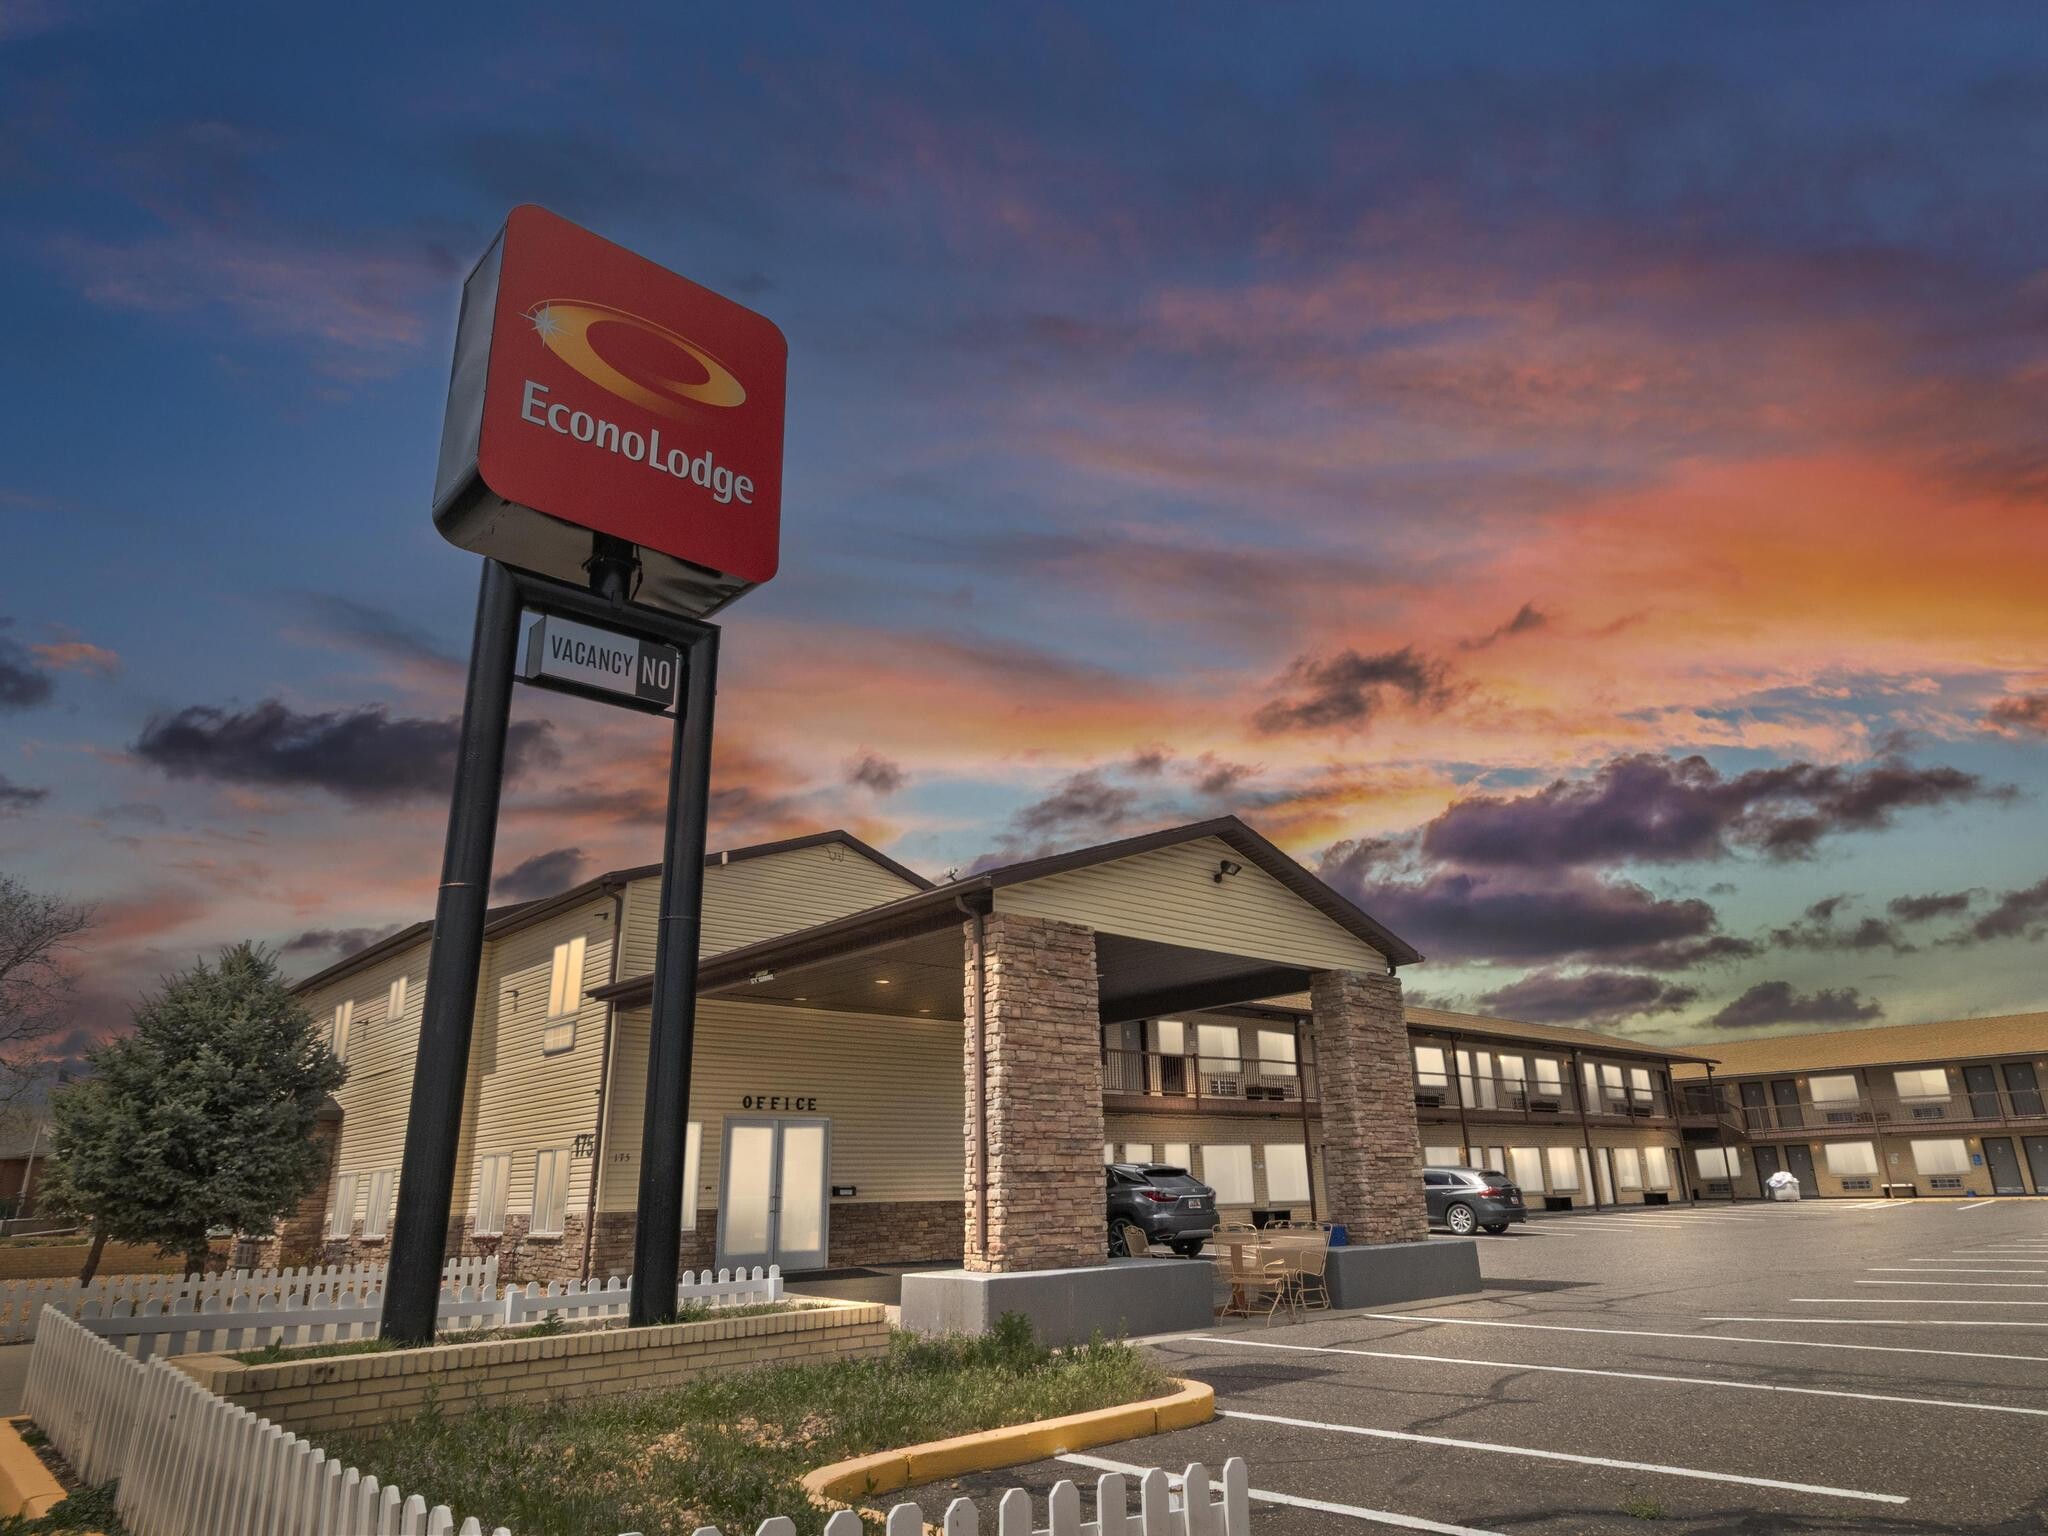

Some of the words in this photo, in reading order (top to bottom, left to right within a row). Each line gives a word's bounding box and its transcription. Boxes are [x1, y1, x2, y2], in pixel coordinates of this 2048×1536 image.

[521, 379, 755, 505] EconoLodge
[551, 634, 634, 677] VACANCY
[641, 656, 671, 690] NO
[742, 1095, 817, 1111] OFFICE
[575, 1134, 594, 1158] 175
